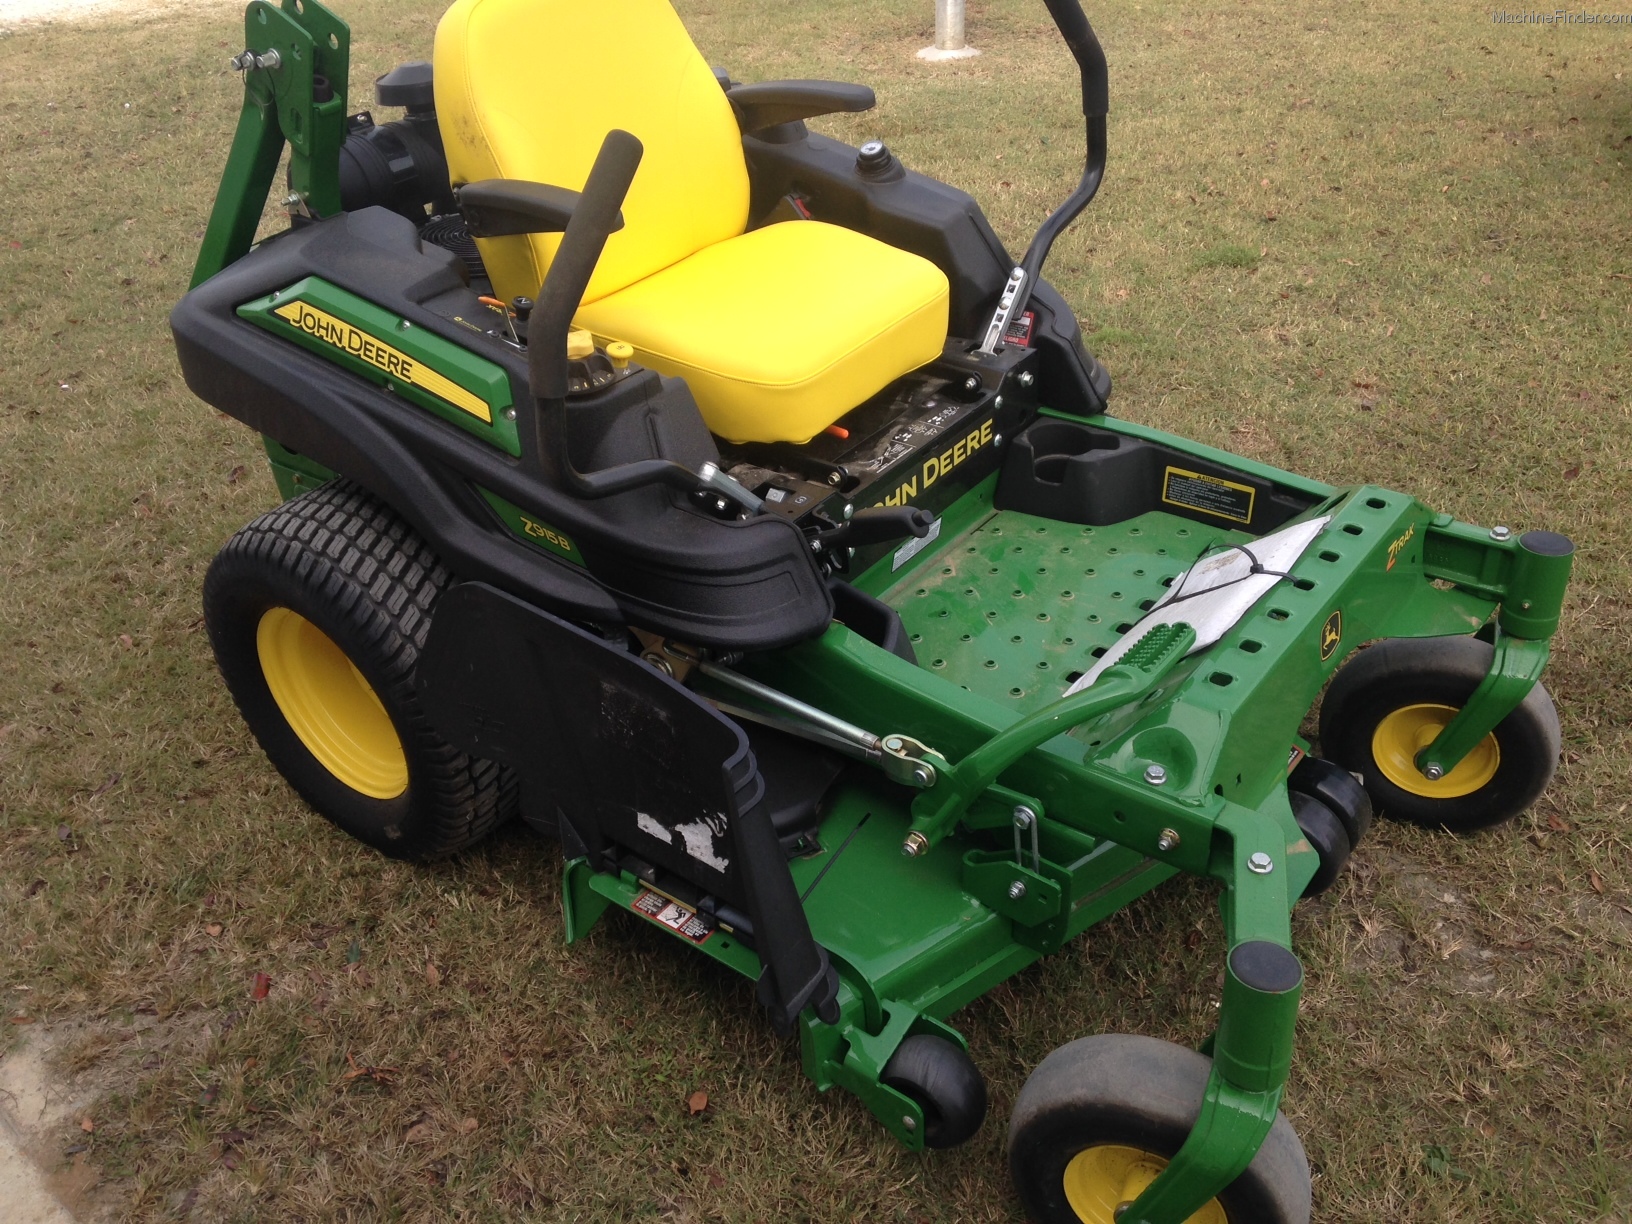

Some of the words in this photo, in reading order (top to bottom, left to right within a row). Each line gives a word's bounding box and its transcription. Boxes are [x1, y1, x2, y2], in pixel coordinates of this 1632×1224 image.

[291, 305, 344, 346] JOHN
[348, 327, 413, 381] DEERE
[866, 474, 918, 508] HN
[922, 417, 994, 490] DEERE
